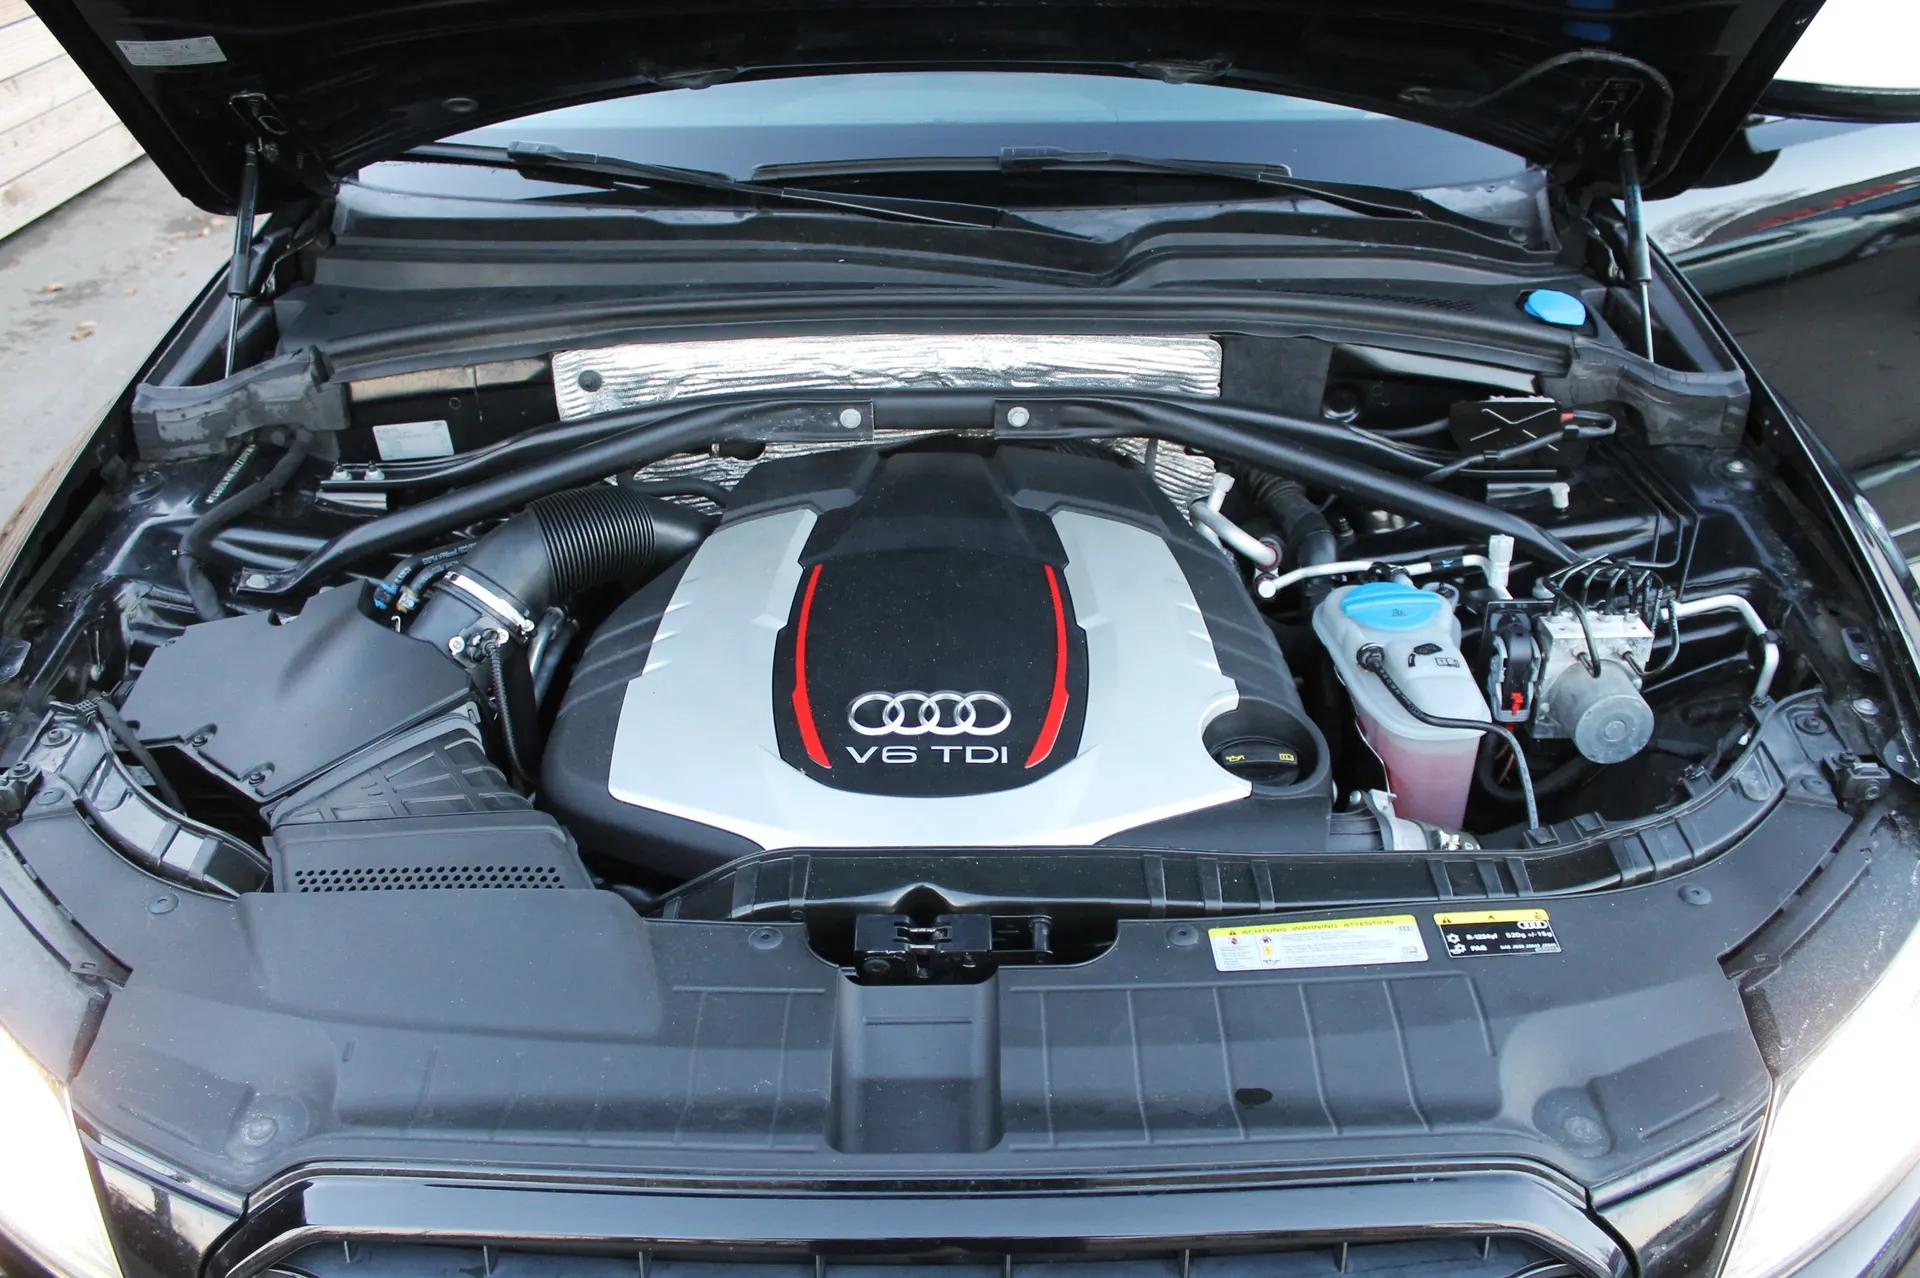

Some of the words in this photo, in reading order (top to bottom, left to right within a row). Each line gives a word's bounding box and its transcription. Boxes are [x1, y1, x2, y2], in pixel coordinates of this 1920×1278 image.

[845, 745, 918, 764] V6
[930, 745, 1008, 764] TDI
[1242, 927, 1287, 935] ACHTUNG
[1292, 923, 1338, 931] WARNING
[1343, 919, 1394, 928] ATTENTION
